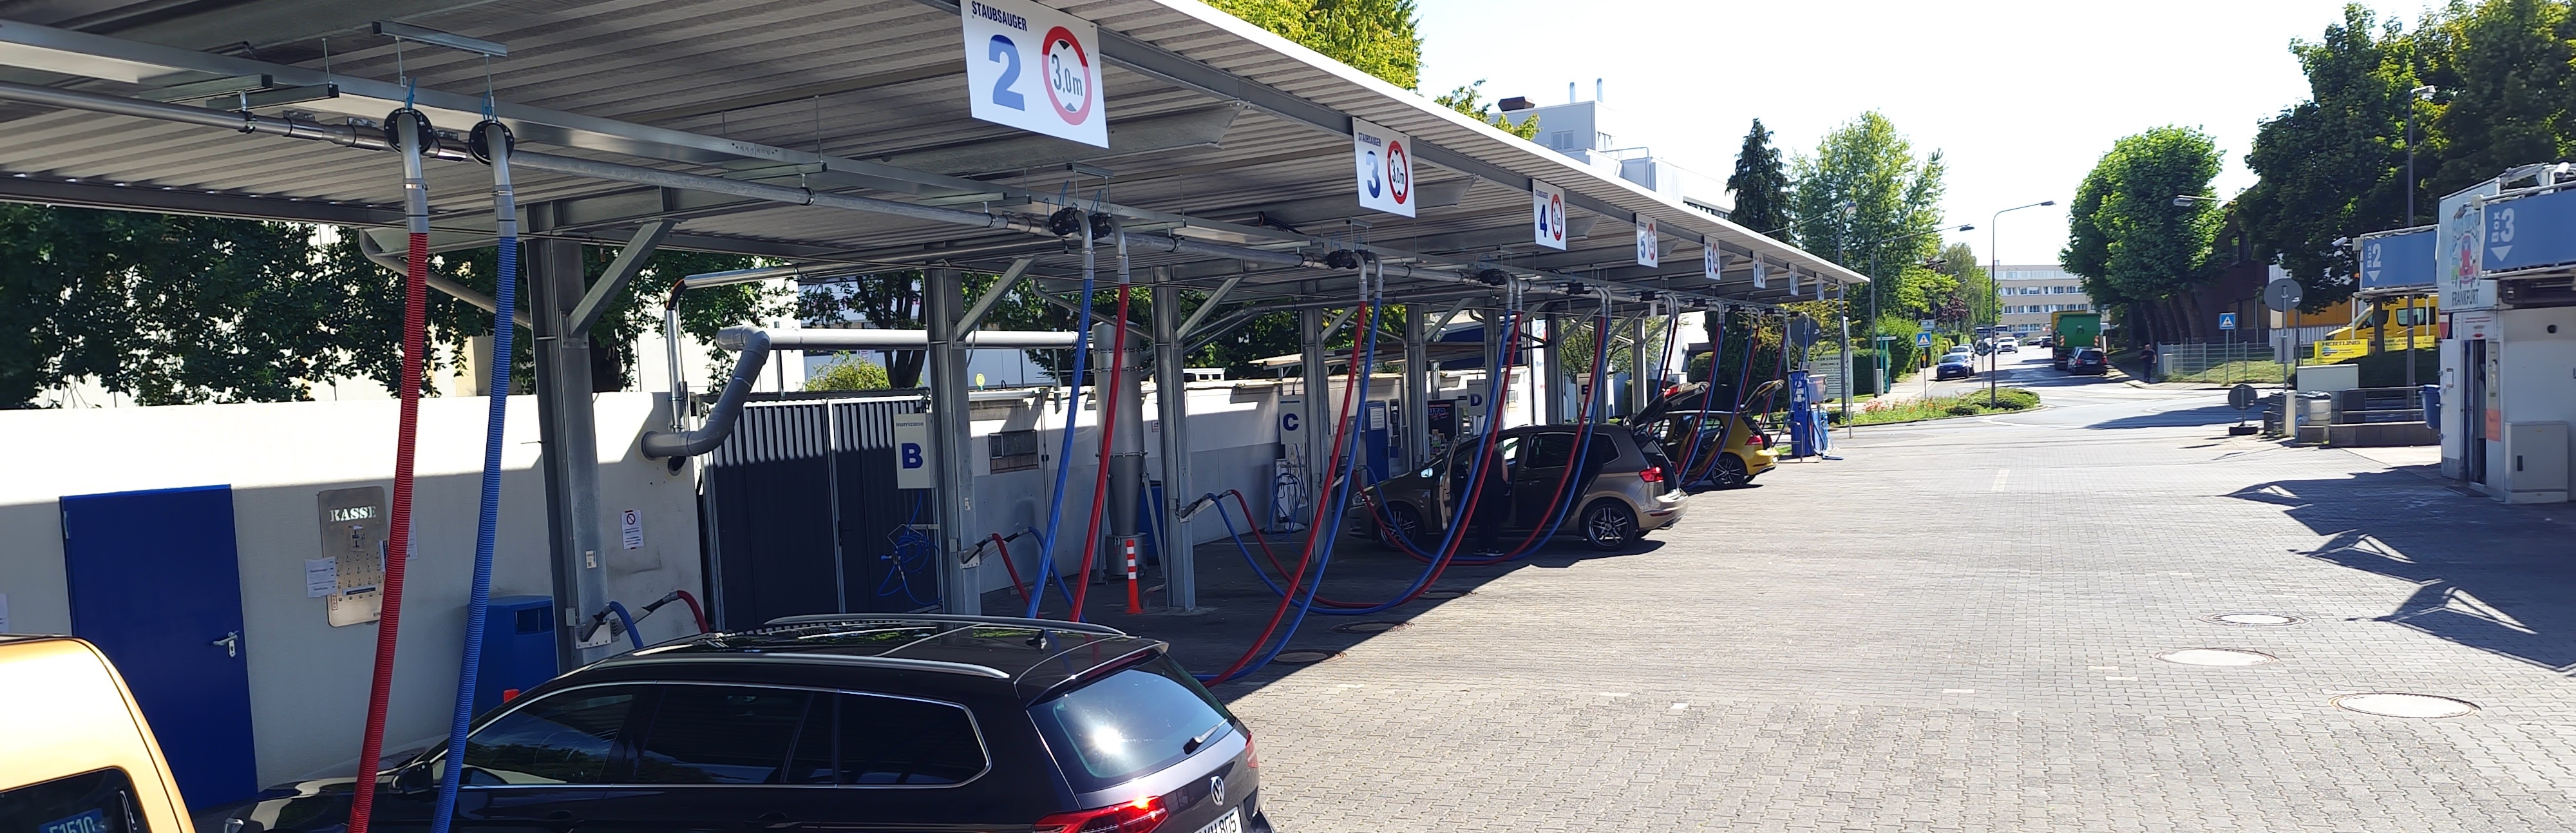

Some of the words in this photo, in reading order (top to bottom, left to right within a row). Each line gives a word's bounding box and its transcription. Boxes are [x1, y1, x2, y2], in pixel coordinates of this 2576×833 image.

[972, 2, 1027, 32] STAUBSAUGER
[989, 34, 1025, 111] 2
[1052, 53, 1083, 97] 3,0m
[1358, 132, 1381, 147] STAUBSAUGER
[1366, 151, 1381, 198] 3
[1540, 204, 1548, 238] 4
[2491, 212, 2500, 242] BOX
[2501, 208, 2514, 242] 3
[1708, 250, 1712, 273] 6
[2372, 243, 2382, 268] 2
[2452, 289, 2479, 307] FRANKFURT
[1428, 407, 1446, 416] UTO
[1470, 394, 1482, 406] D
[1283, 413, 1299, 431] C
[902, 443, 923, 469] B
[330, 506, 376, 522] KASSE
